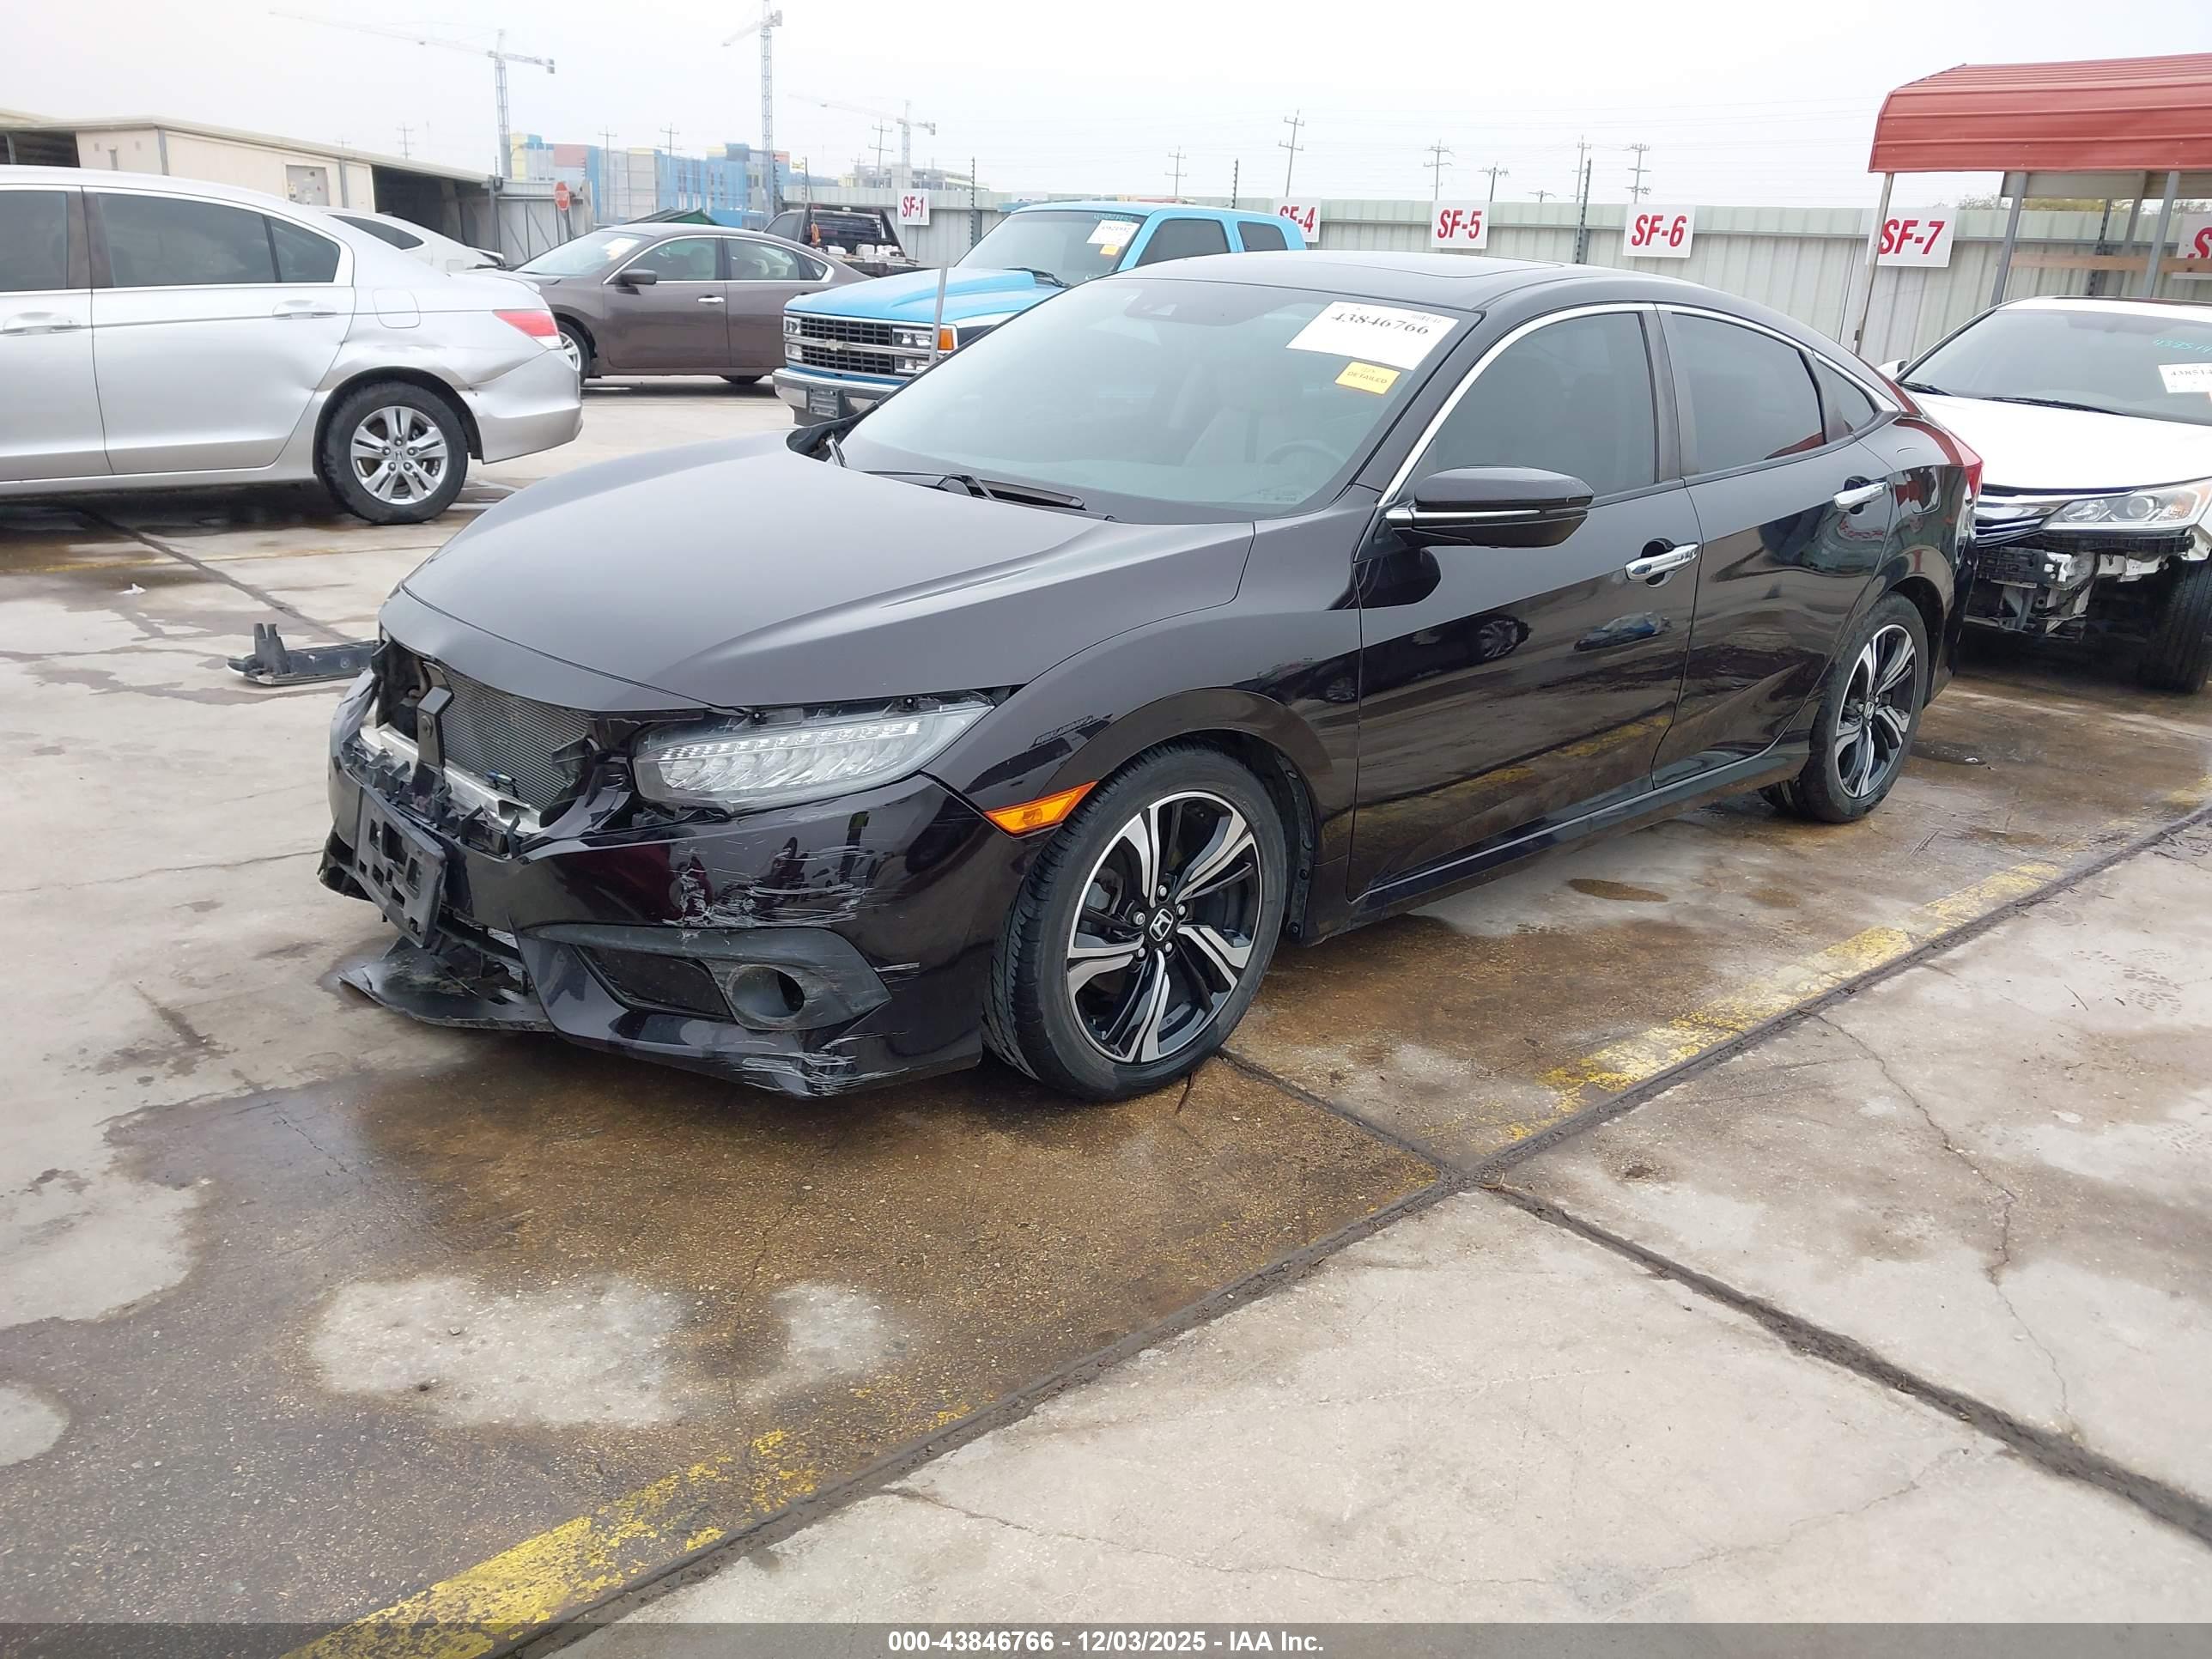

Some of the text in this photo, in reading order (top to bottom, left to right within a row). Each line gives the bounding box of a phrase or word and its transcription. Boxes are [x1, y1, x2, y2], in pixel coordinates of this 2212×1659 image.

[902, 196, 924, 217] SF-1
[1437, 209, 1482, 239] SF-5
[1632, 214, 1686, 246] SF-6
[1878, 219, 1946, 254] SF-7
[1331, 313, 1429, 335] 43846766
